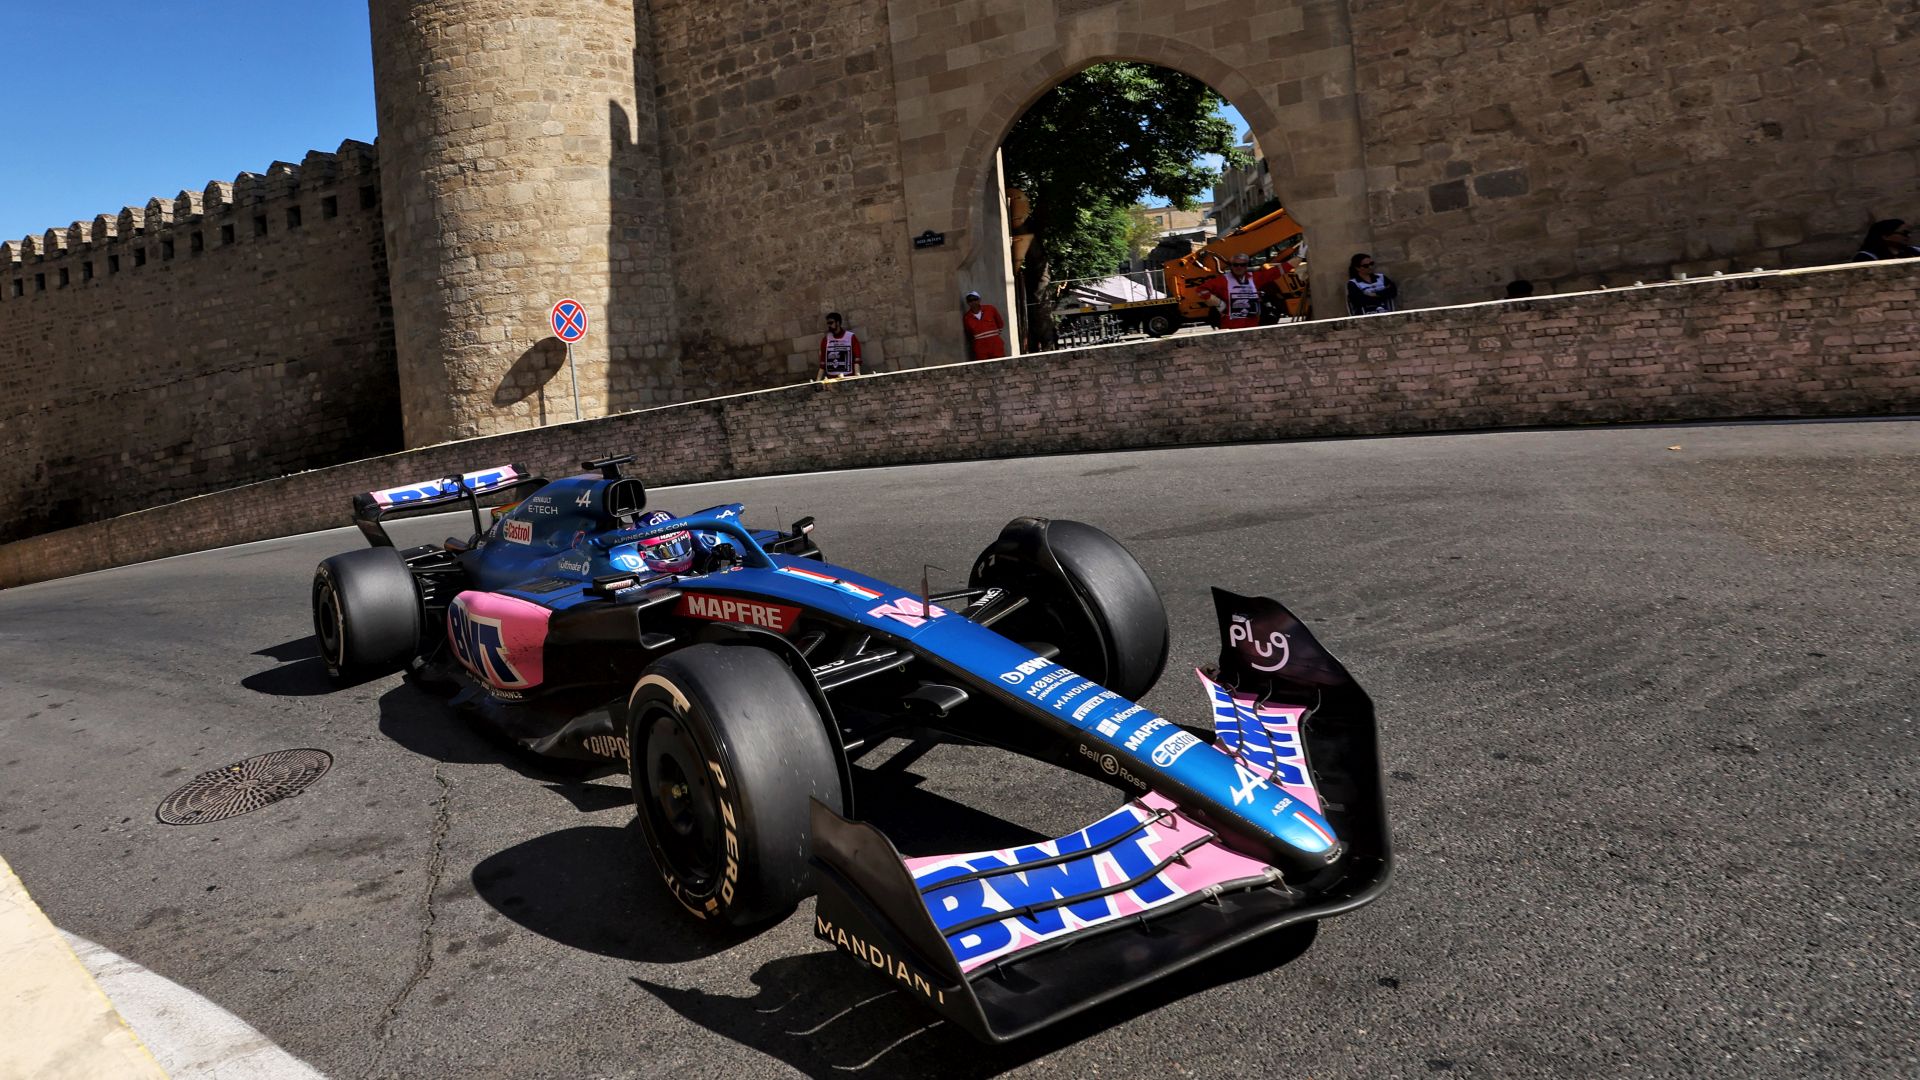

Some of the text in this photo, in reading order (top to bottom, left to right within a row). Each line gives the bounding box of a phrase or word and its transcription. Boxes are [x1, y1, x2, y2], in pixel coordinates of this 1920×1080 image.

[508, 521, 531, 541] Castrol
[613, 521, 688, 545] ALPINECARS.COM
[687, 595, 783, 630] MAPFRE
[1015, 656, 1055, 676] BWT
[590, 735, 631, 759] DUPO
[1079, 743, 1147, 790] Bell & Ross
[708, 760, 740, 906] P ZERO
[914, 807, 1182, 964] BWT
